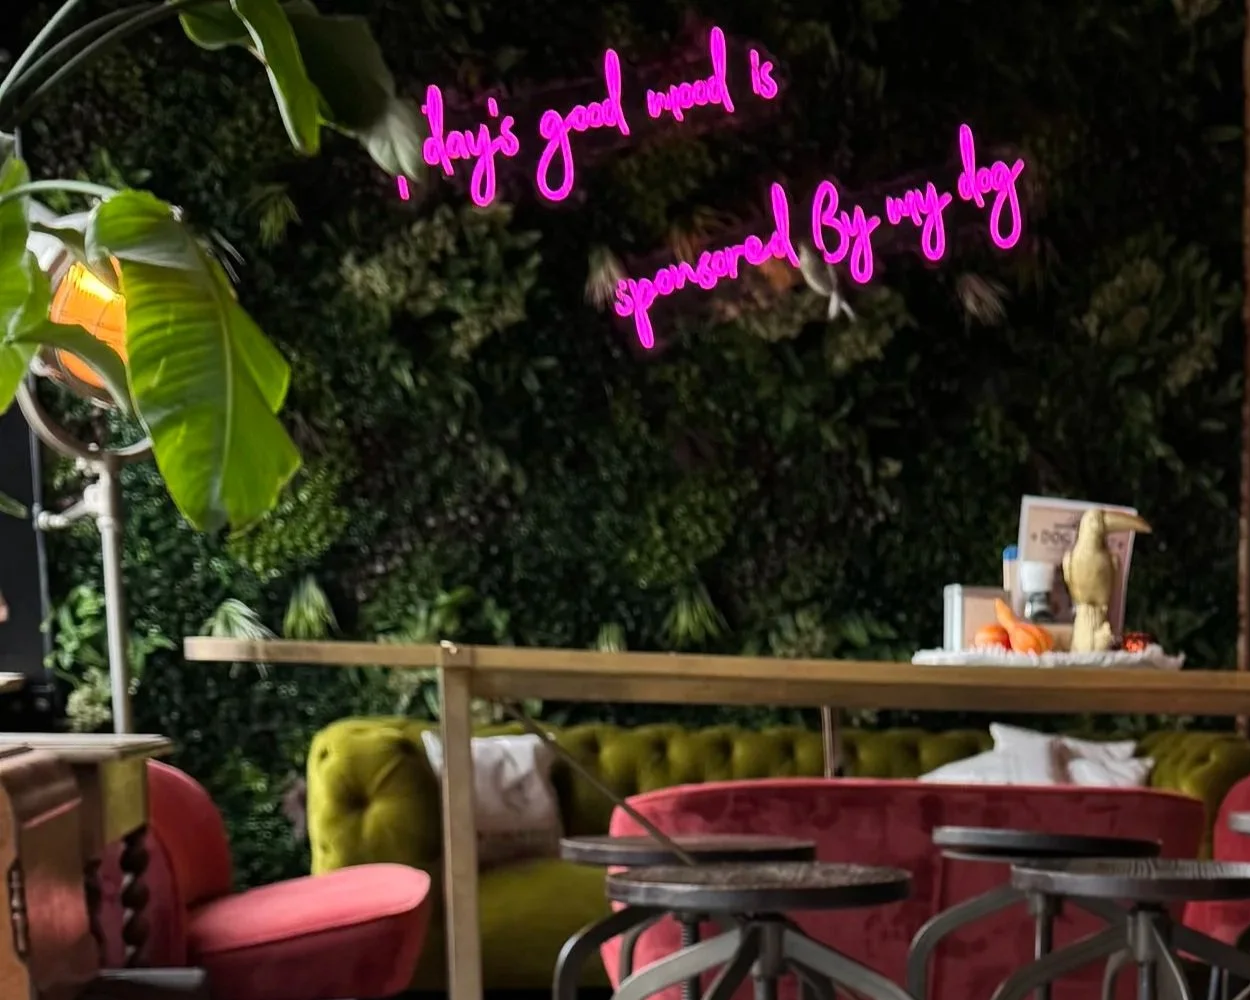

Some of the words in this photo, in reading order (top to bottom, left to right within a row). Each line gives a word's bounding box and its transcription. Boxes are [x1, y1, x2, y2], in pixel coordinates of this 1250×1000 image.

[537, 50, 629, 200] good
[647, 27, 734, 121] mood
[615, 183, 800, 348] sponsored
[886, 184, 952, 260] my
[958, 125, 1024, 248] dog
